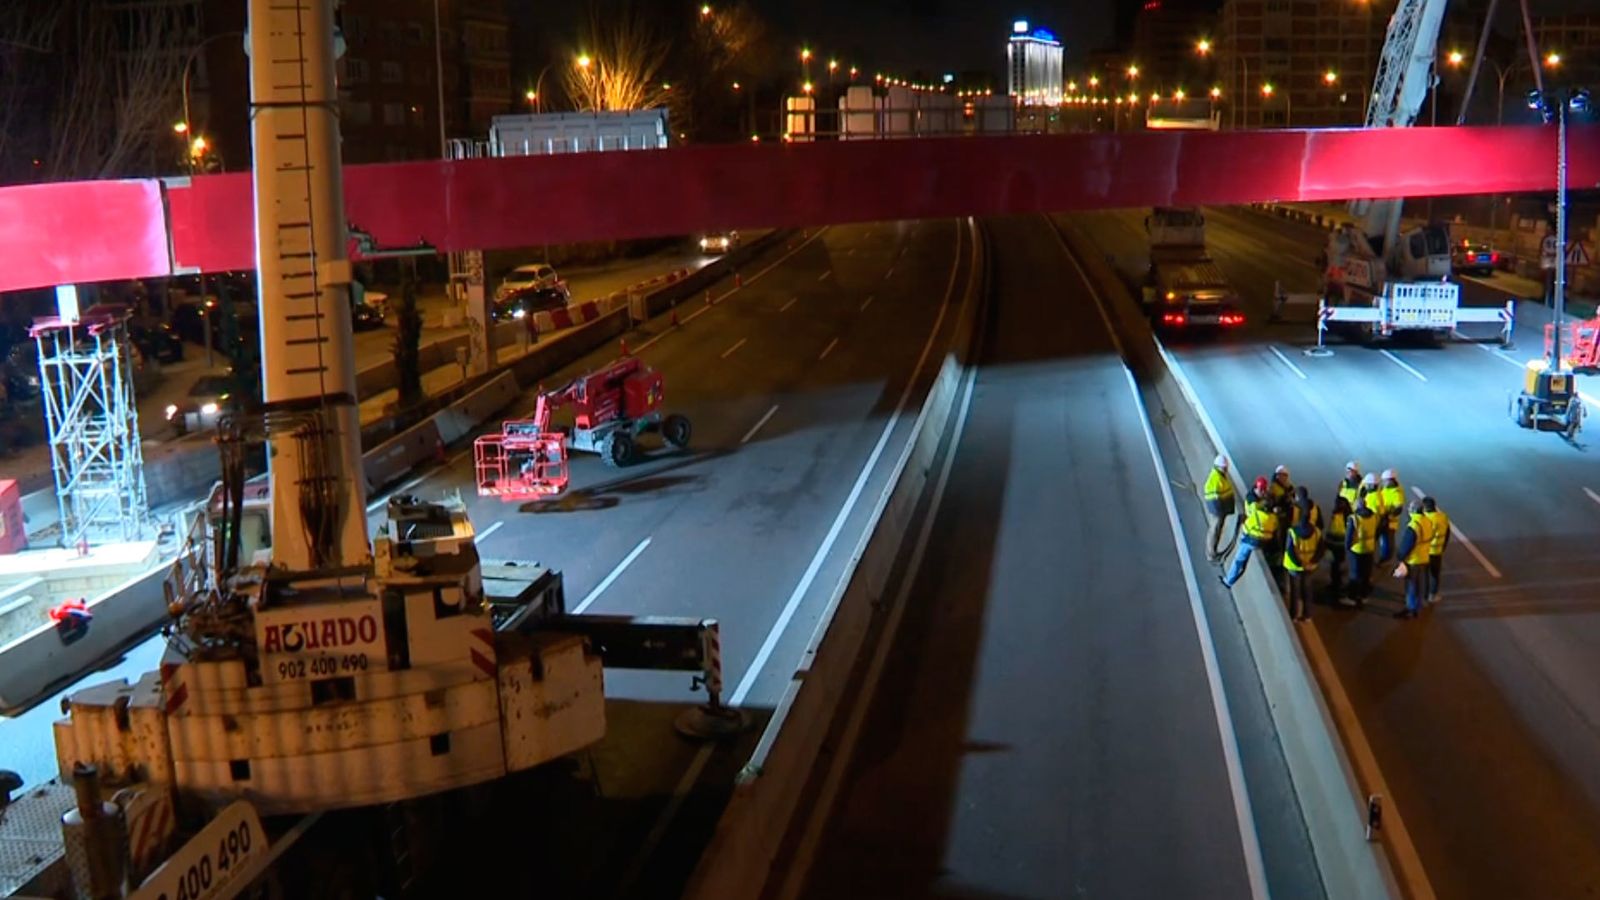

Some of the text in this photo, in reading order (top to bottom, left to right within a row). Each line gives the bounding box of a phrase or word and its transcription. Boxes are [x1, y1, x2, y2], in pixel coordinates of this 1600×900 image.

[278, 653, 368, 680] 902 400 490
[176, 854, 212, 900] 400
[218, 820, 251, 871] 490
